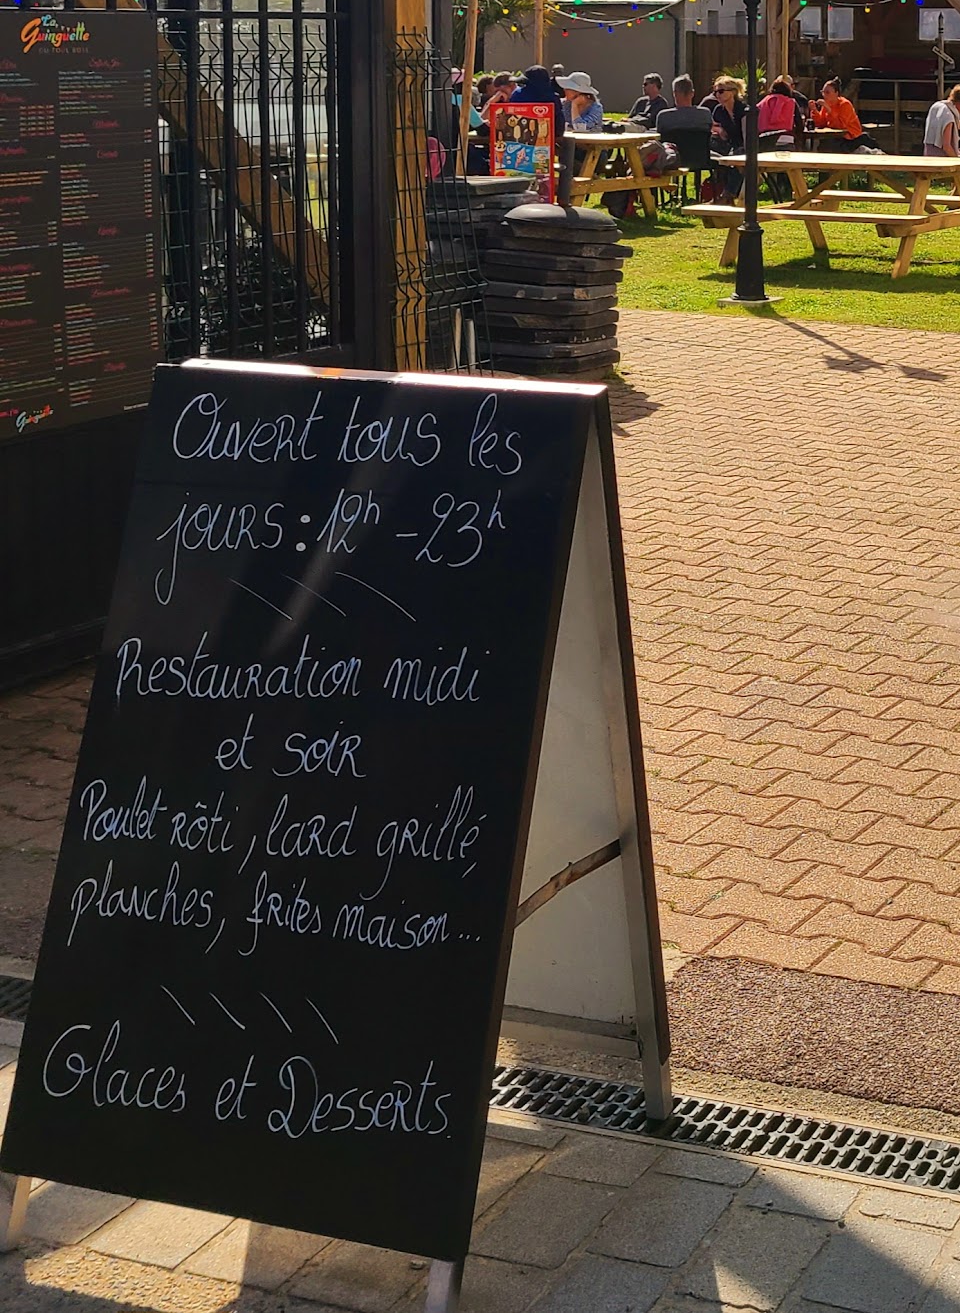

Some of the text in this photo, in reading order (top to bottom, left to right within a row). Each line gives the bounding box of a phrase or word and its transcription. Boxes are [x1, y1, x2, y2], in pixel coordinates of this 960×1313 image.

[20, 17, 90, 53] Guinguette
[173, 391, 525, 476] Ouvert tous les
[115, 630, 491, 706] Restauration midi
[215, 713, 256, 772] et
[79, 775, 167, 843] Poulet
[265, 793, 358, 859] lard
[238, 870, 323, 956] frites
[42, 1019, 188, 1113] Glaces
[214, 1053, 258, 1121] et
